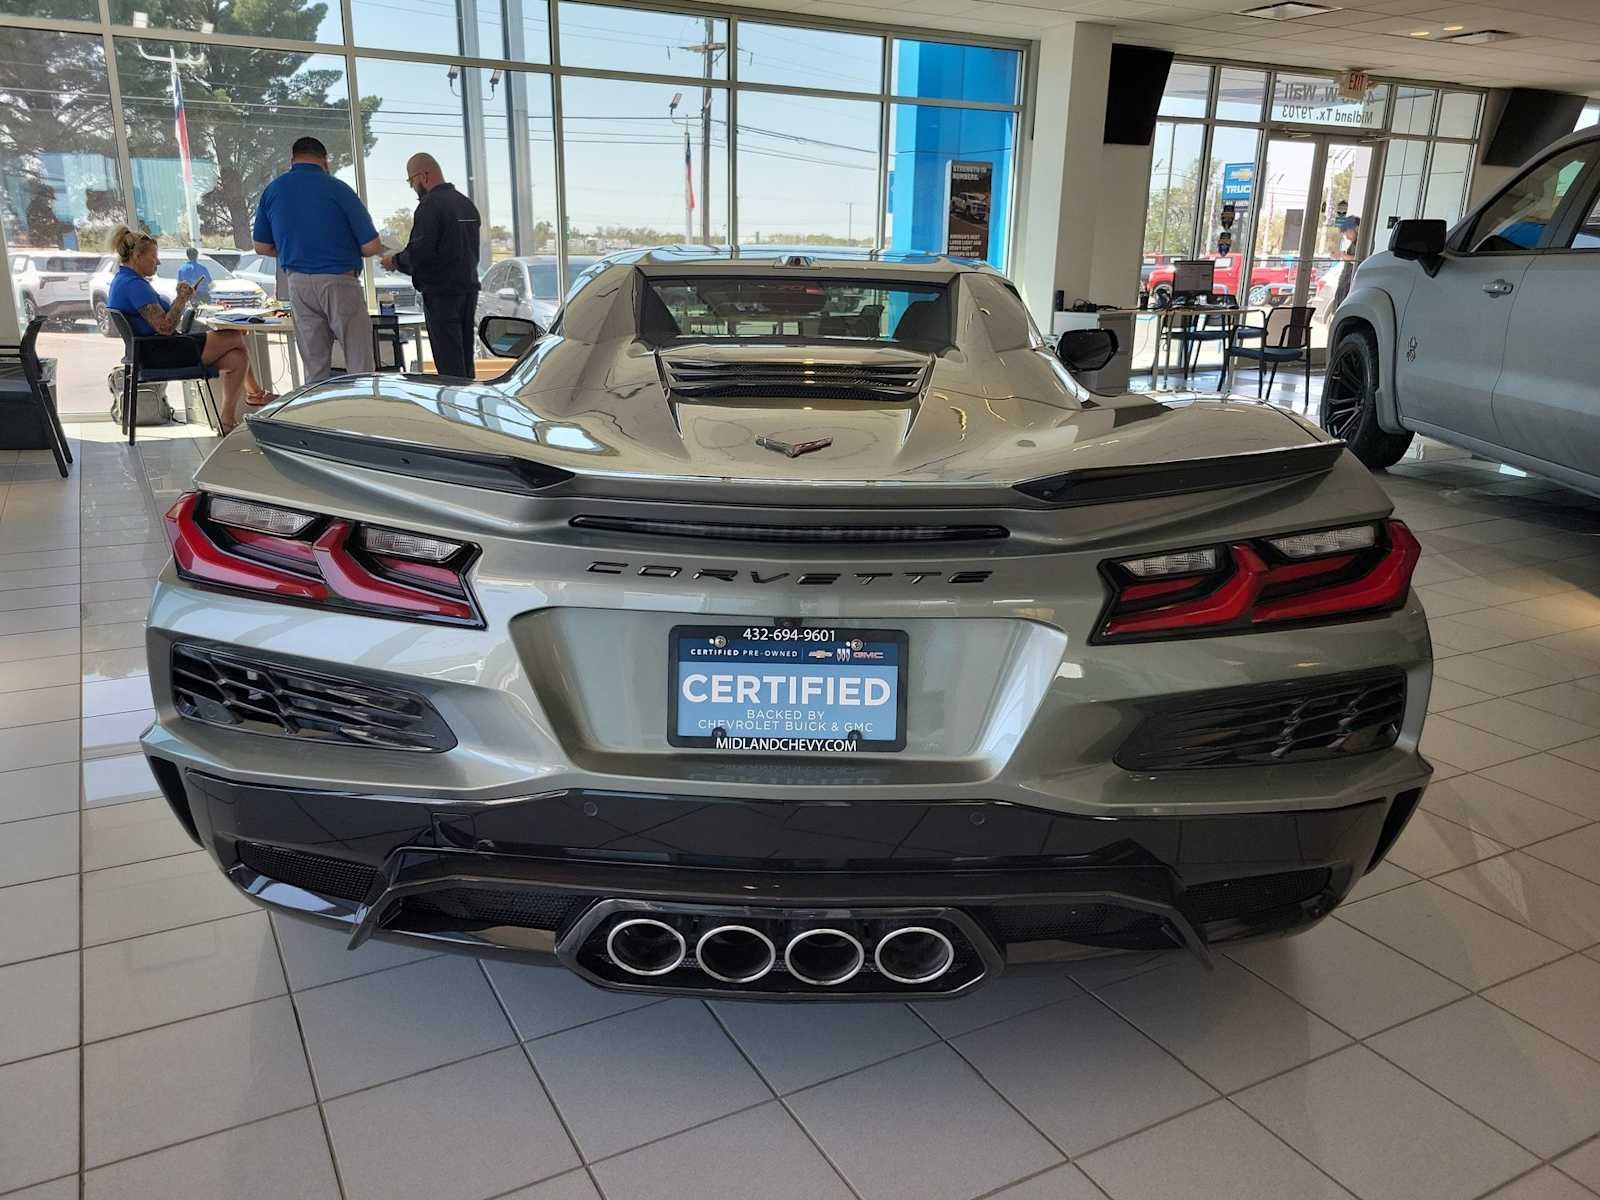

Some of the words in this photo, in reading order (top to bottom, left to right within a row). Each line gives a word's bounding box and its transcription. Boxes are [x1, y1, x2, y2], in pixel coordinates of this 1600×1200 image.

[1349, 72, 1367, 90] EXIT
[585, 561, 993, 585] CORVETTE
[743, 628, 836, 641] 432-694-9601
[690, 648, 739, 656] CERTIFIED
[853, 651, 884, 659] GMC
[682, 674, 891, 706] CERTIFIED
[747, 710, 802, 720] BACKED
[808, 711, 825, 720] BY
[698, 719, 779, 731] CHEVROLET
[785, 721, 826, 731] BUICK
[831, 722, 839, 732] &
[844, 722, 873, 732] GMC
[716, 737, 857, 752] MIDLANDCHEVY.COM
